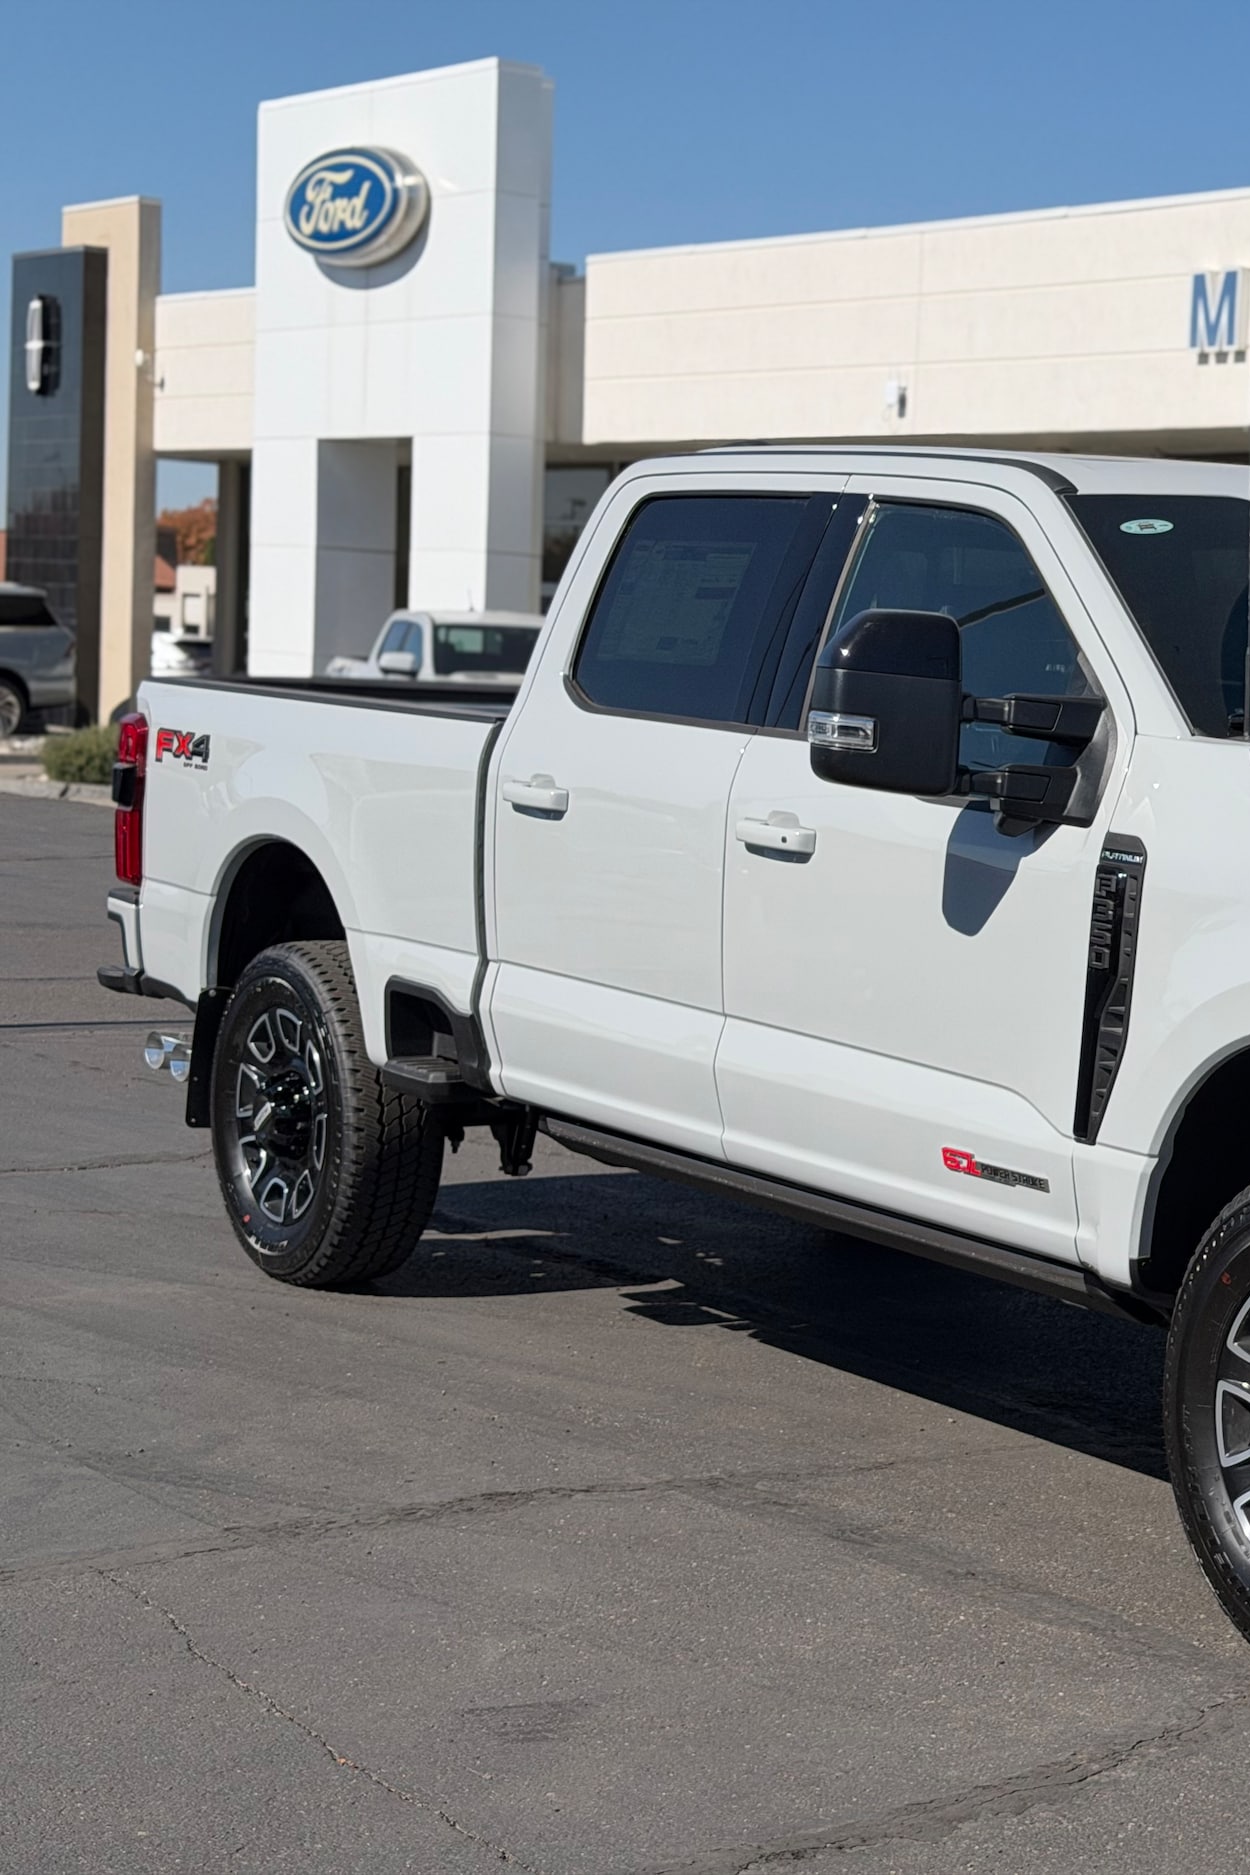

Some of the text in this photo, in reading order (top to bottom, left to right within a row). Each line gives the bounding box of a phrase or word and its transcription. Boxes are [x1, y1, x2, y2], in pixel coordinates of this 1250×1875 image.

[299, 169, 372, 236] Ford
[155, 727, 211, 763] FX4
[1101, 850, 1144, 864] PLATINUM
